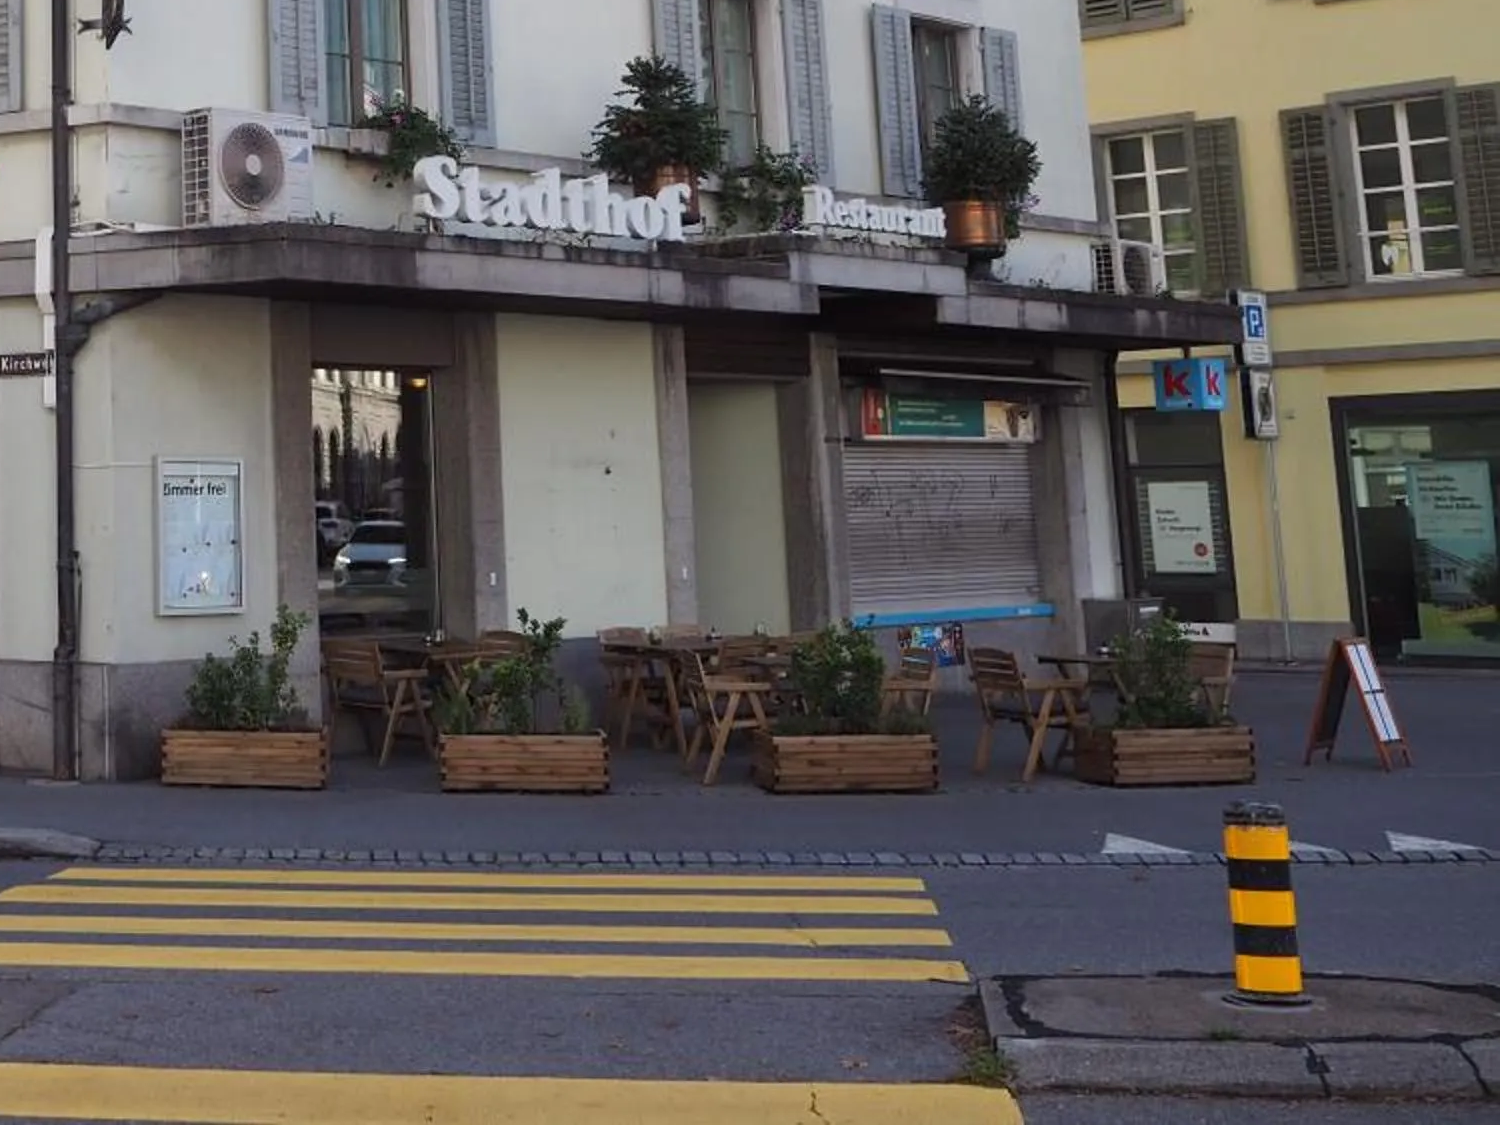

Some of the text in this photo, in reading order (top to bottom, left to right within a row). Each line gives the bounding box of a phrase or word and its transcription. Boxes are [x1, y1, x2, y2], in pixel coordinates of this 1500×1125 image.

[412, 154, 691, 242] Stadthof
[801, 184, 947, 238] Restaurant
[164, 481, 226, 497] Zimmer frei
